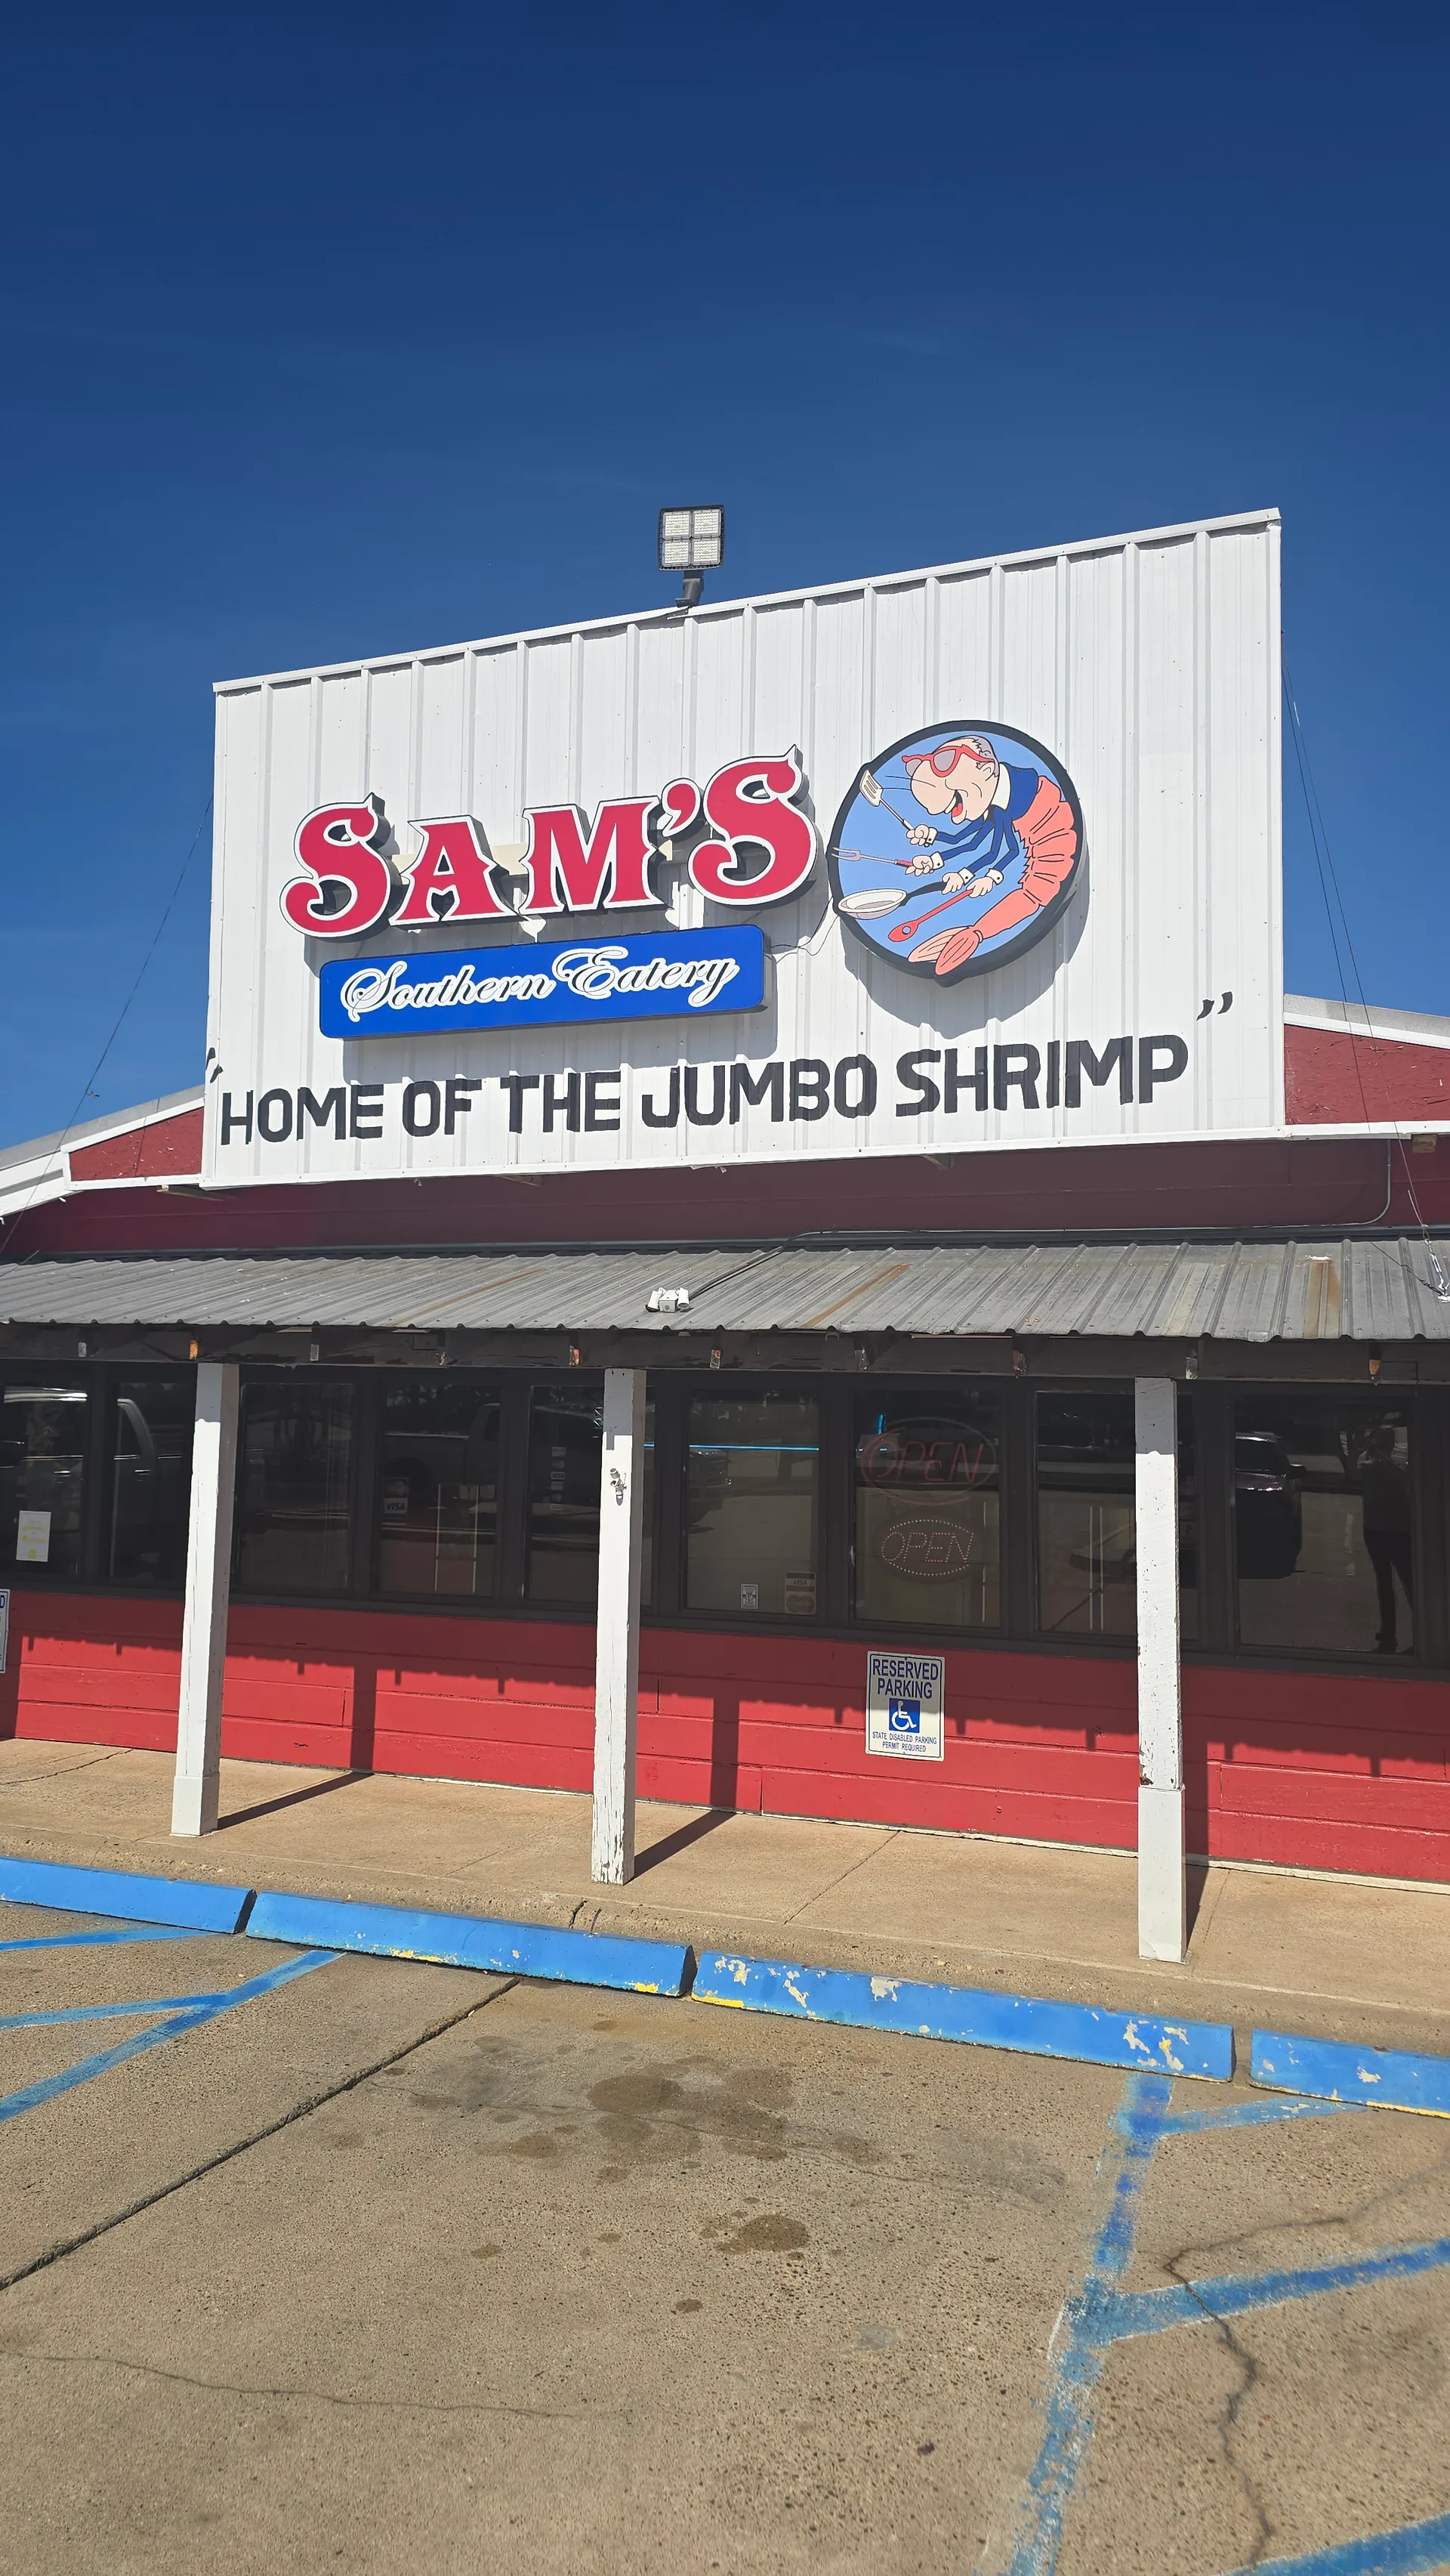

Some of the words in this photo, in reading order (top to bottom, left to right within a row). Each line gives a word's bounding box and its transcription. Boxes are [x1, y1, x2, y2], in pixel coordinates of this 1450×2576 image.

[279, 745, 819, 939] SAM'S
[341, 961, 556, 1023] Southern
[553, 946, 740, 1008] Eatery
[403, 1078, 483, 1137] OF
[500, 1070, 622, 1135] THE
[641, 1053, 878, 1129] JUMBO
[869, 1441, 985, 1483] OPEN
[386, 1502, 406, 1511] VISA
[881, 1532, 974, 1563] OPEN
[872, 1658, 939, 1680] RESERVED
[878, 1678, 933, 1699] PARKING
[872, 1731, 887, 1740] STATE
[890, 1733, 913, 1743] DISABLED
[915, 1736, 937, 1745] PARKING
[882, 1741, 899, 1750] PERMIT
[902, 1744, 927, 1753] REQUIRED
